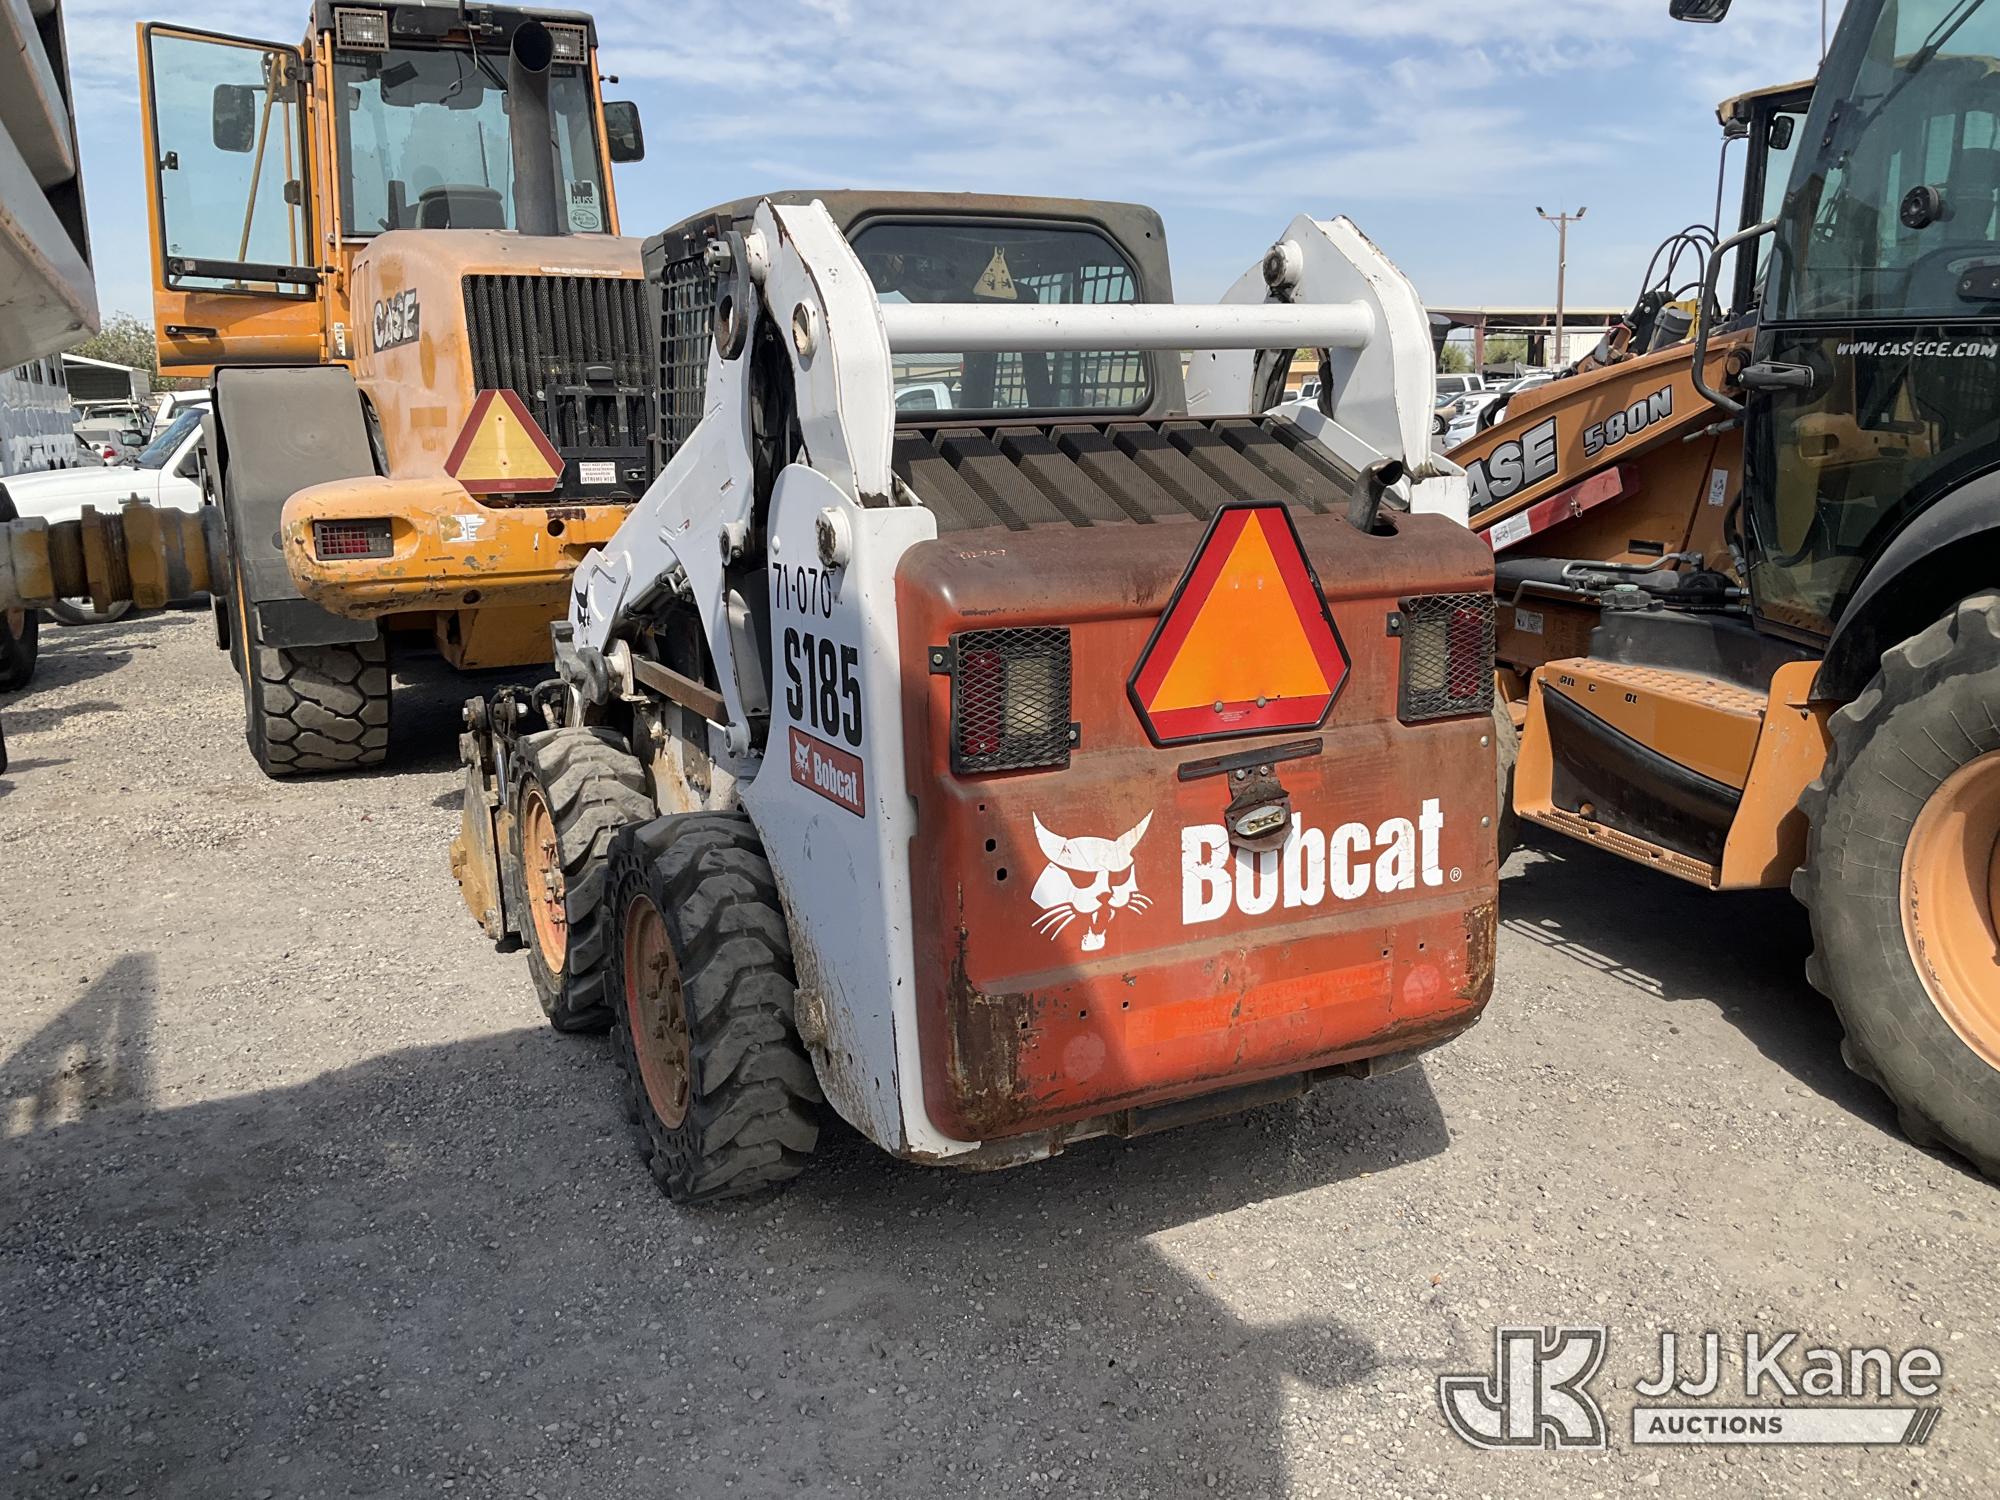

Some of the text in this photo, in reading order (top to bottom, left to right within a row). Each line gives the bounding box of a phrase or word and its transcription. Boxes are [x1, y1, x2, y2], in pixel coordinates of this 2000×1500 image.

[373, 290, 418, 350] CASE
[1836, 341, 1998, 357] WWW.CASECE.COM
[1583, 385, 1672, 457] 580N
[1468, 417, 1557, 511] ASE
[784, 627, 862, 747] S185
[813, 752, 858, 805] Bobcat
[1181, 798, 1444, 925] Bobcat
